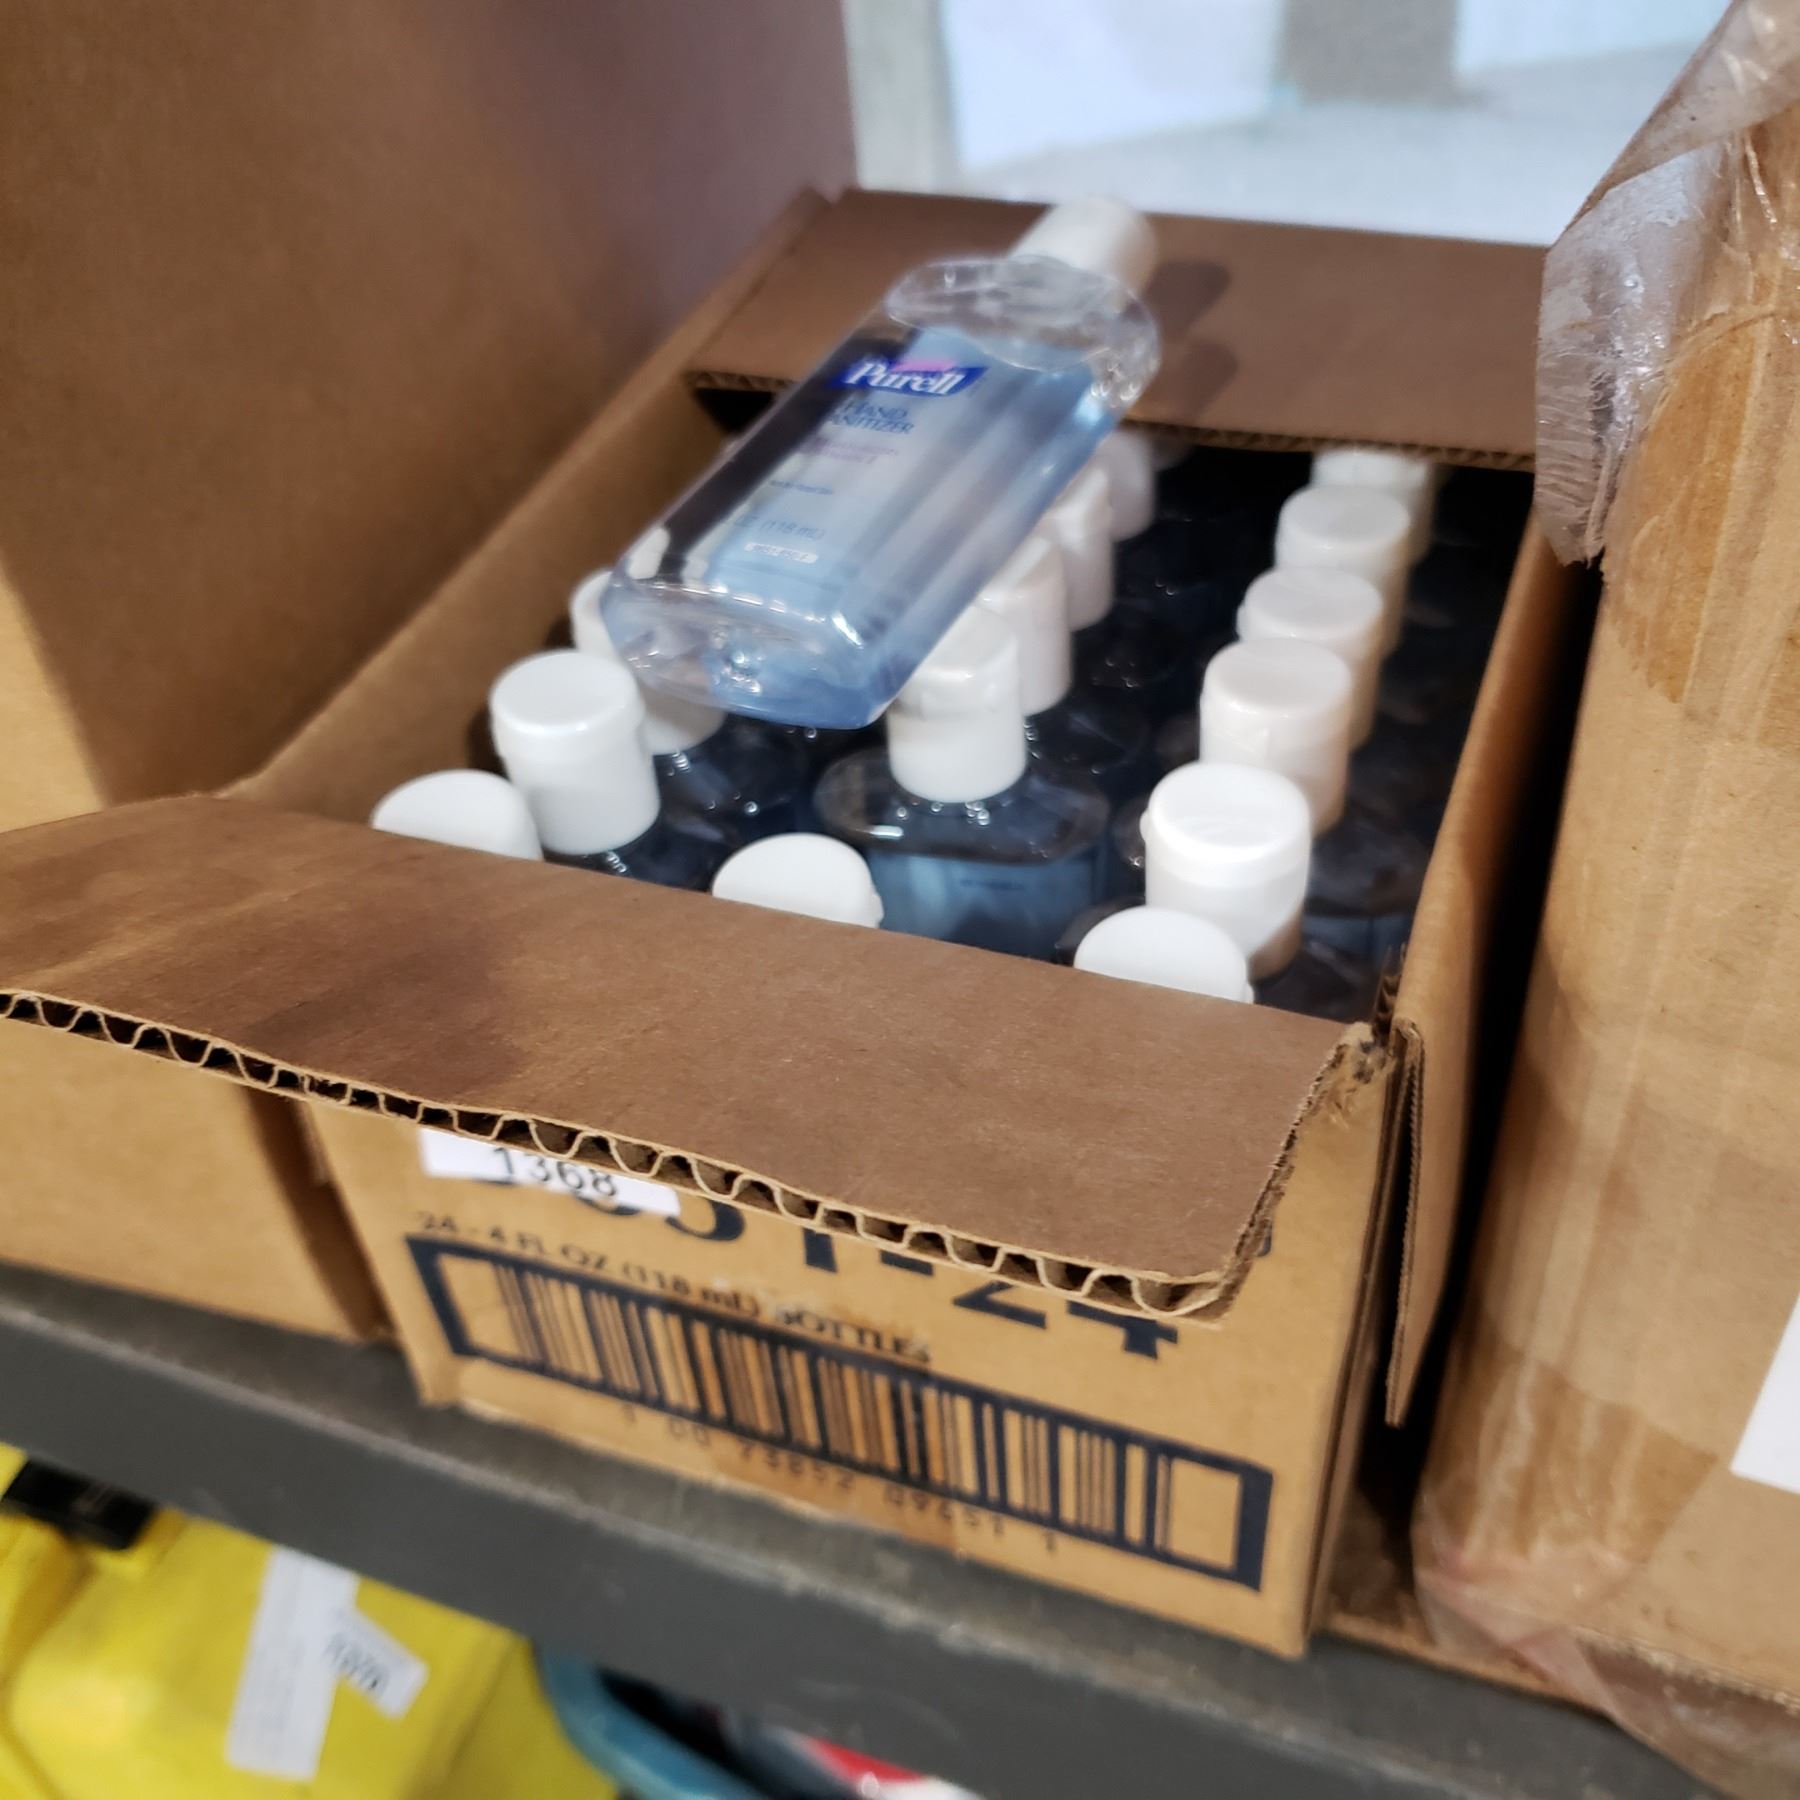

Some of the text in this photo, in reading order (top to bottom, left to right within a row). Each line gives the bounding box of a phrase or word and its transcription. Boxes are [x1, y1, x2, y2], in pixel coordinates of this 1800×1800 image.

[846, 360, 965, 395] Purell
[828, 414, 914, 433] ANITIZER
[493, 1146, 619, 1199] 1368
[562, 1244, 608, 1269] OZ
